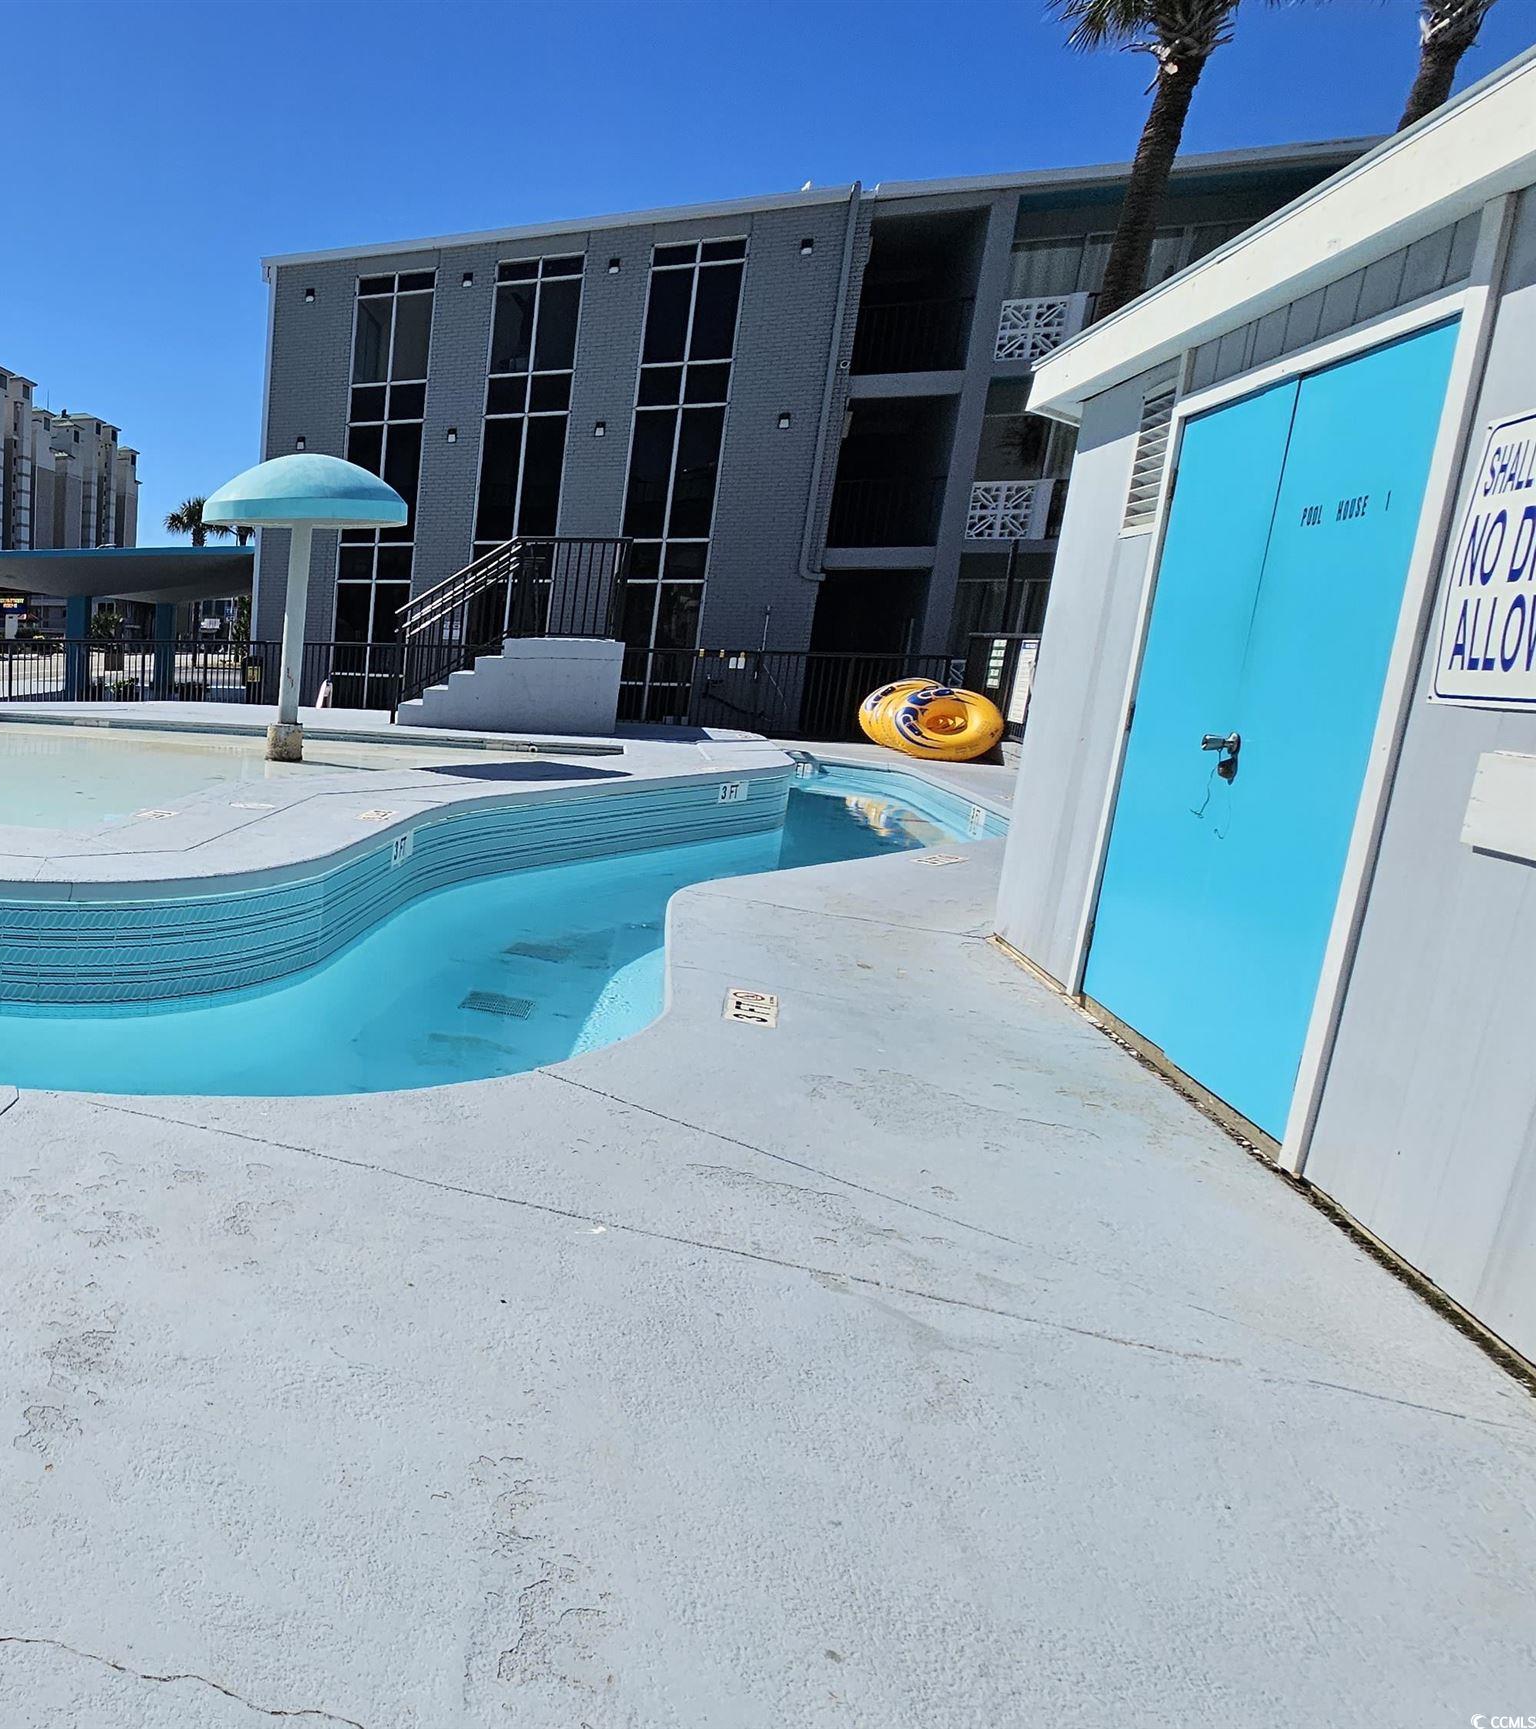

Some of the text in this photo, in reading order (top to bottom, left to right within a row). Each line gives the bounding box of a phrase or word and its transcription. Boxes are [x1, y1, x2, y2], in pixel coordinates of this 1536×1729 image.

[1300, 504, 1323, 527] POOL
[1336, 495, 1369, 521] HOUSE
[1458, 509, 1507, 587] NO
[721, 784, 740, 800] 3 FT
[733, 1000, 771, 1023] 3 FT
